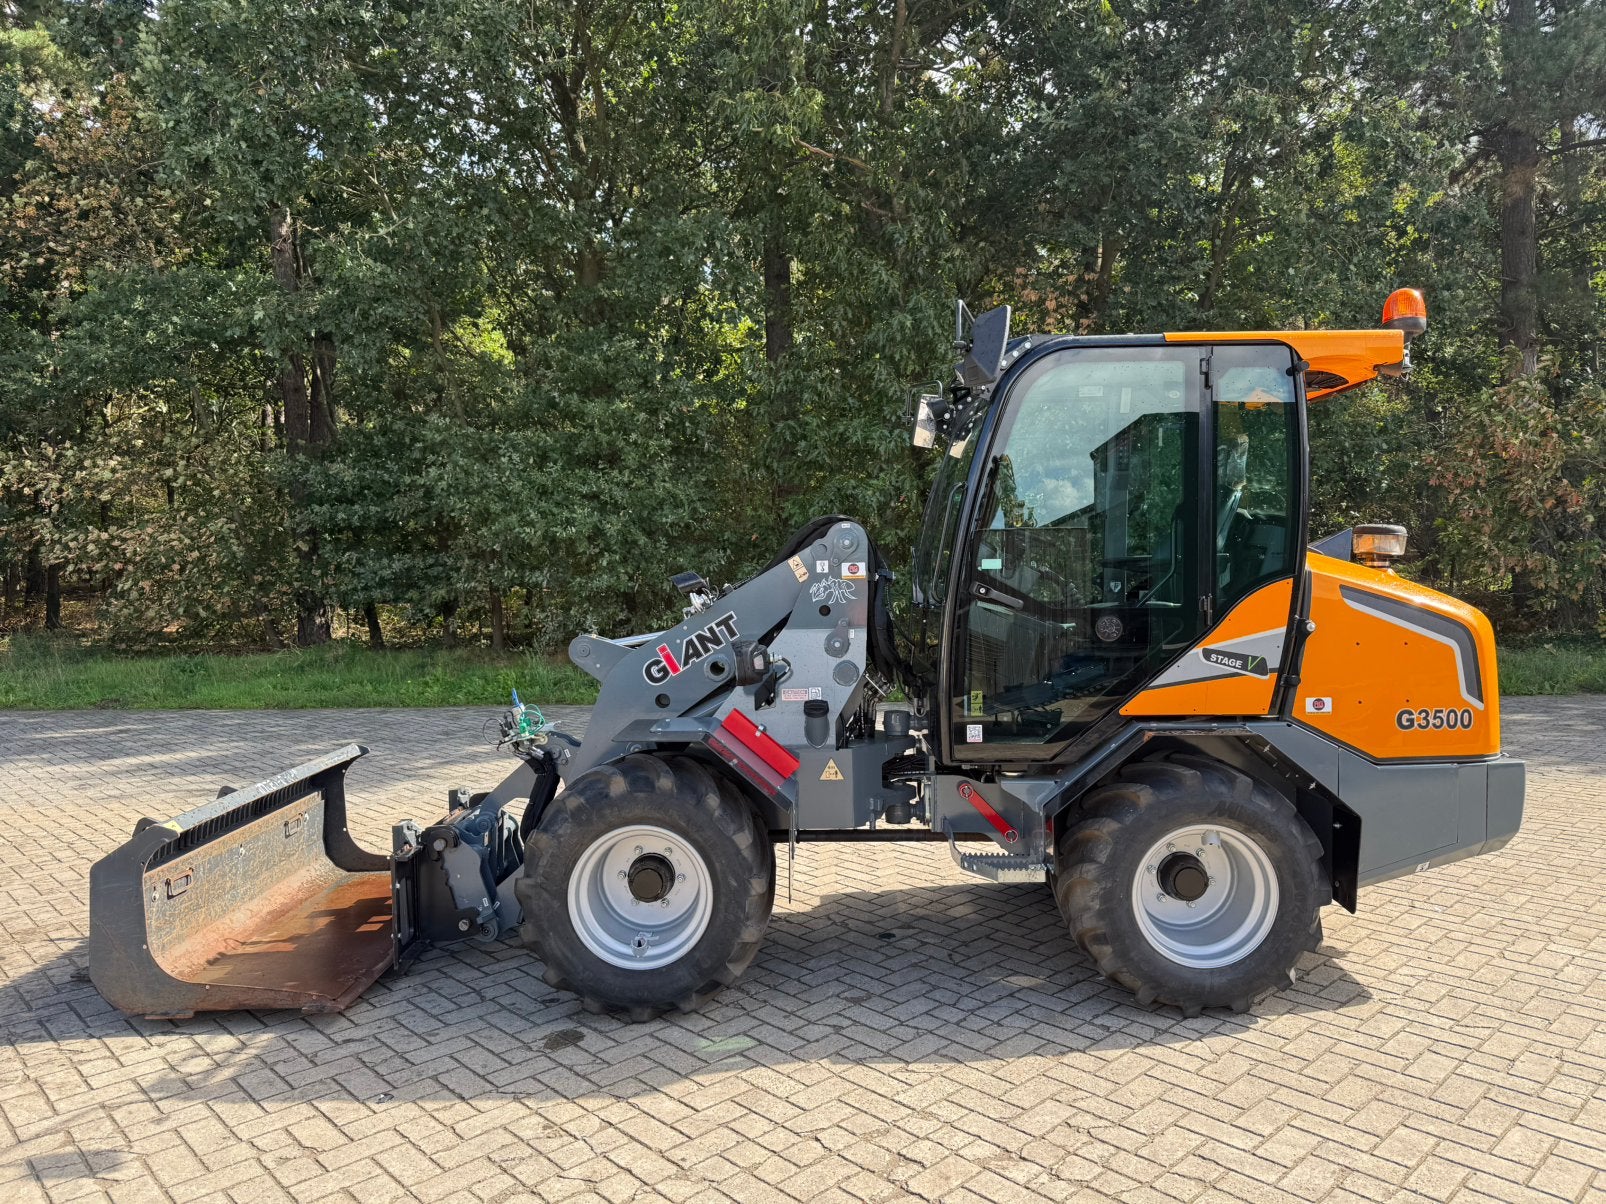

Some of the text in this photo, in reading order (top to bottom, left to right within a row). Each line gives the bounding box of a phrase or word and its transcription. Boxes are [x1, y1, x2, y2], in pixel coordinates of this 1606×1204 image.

[1210, 653, 1264, 671] STAGE V
[1396, 708, 1473, 731] G3500
